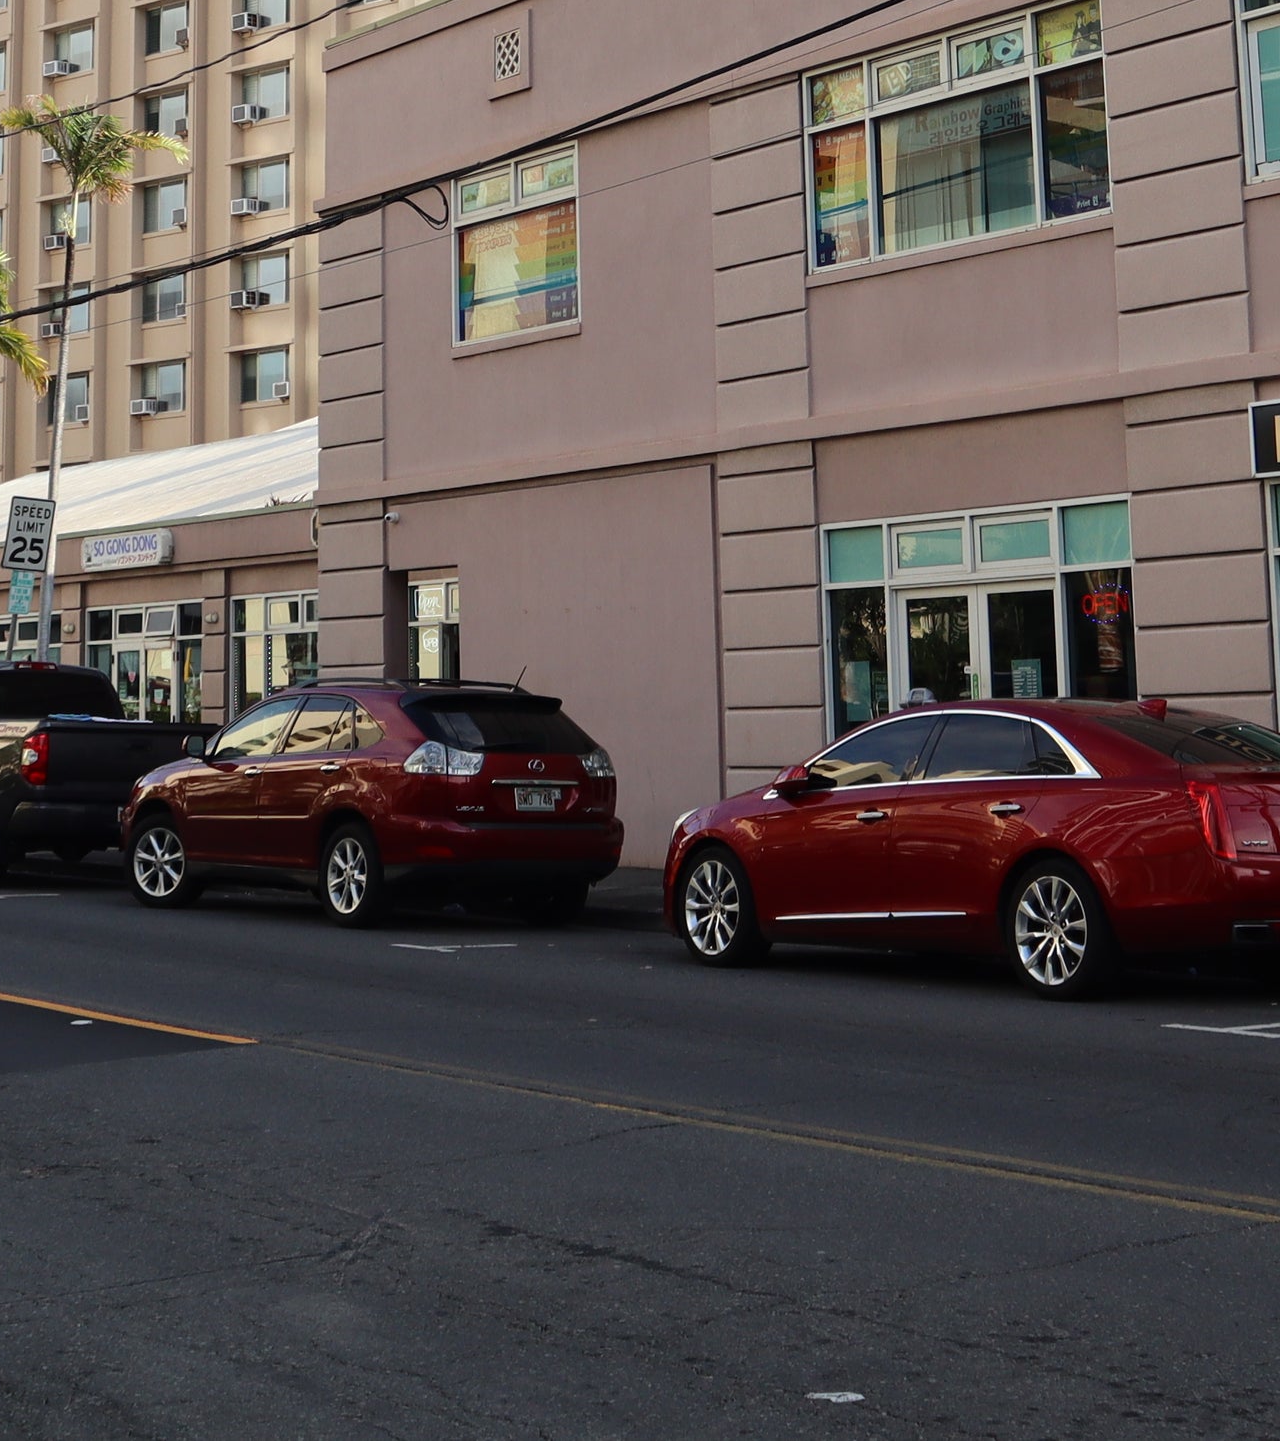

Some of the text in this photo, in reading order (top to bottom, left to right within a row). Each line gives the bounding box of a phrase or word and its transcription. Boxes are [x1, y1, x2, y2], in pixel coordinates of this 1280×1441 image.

[839, 69, 861, 83] MENU
[14, 505, 52, 519] SPEED
[15, 521, 45, 534] LIMIT
[8, 536, 44, 564] 25
[94, 534, 158, 557] SO GONG DONG
[1081, 592, 1129, 615] OPEN
